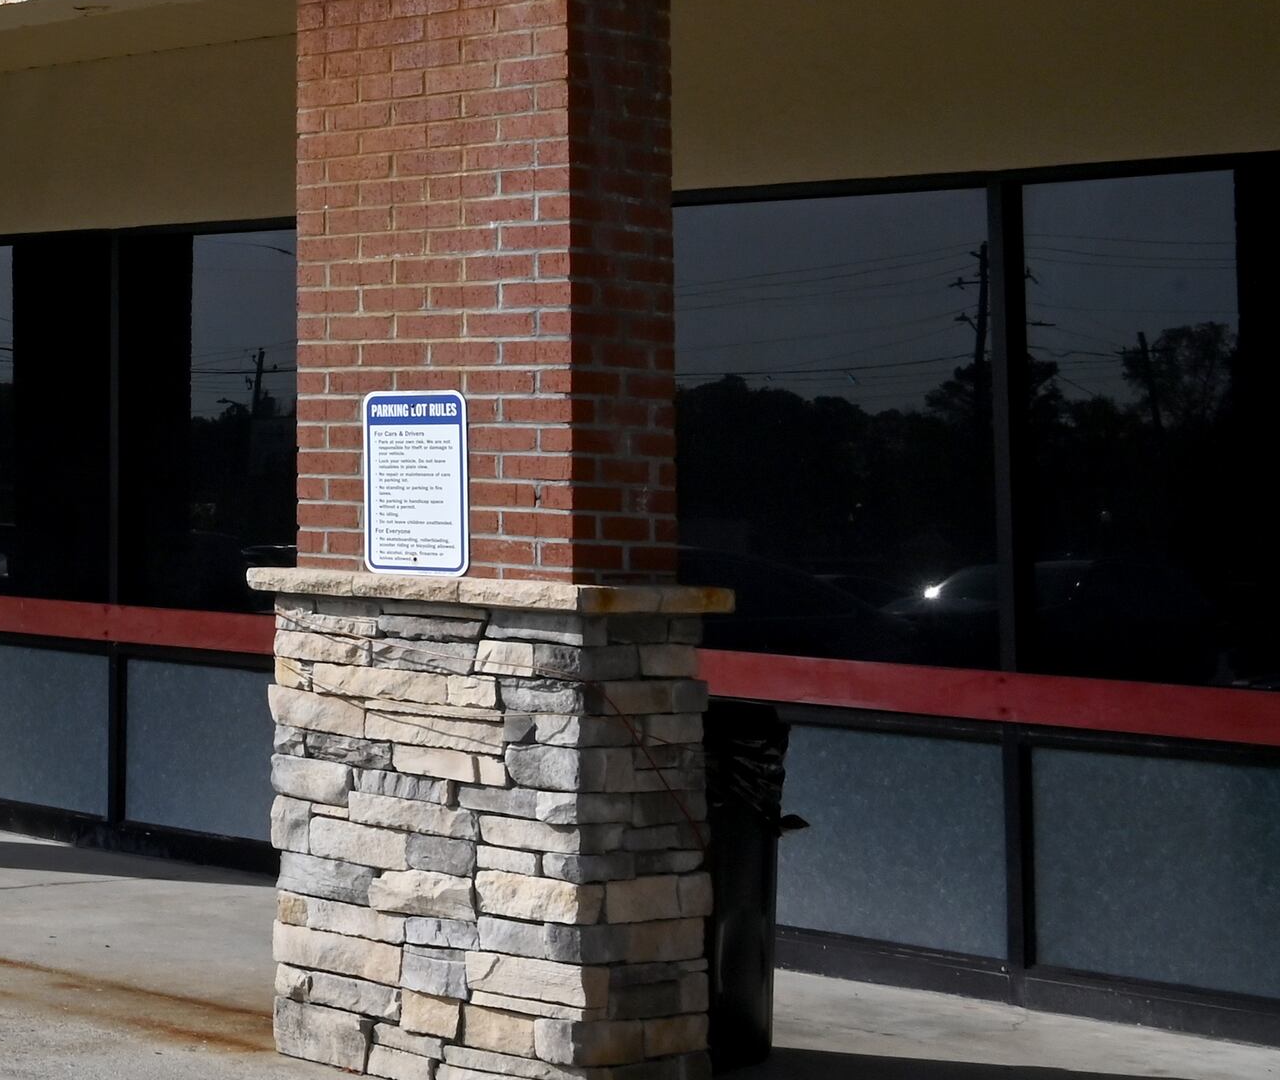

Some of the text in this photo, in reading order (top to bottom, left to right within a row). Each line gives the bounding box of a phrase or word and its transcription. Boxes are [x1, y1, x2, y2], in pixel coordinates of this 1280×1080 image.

[371, 403, 457, 417] PARKING LOT RULES
